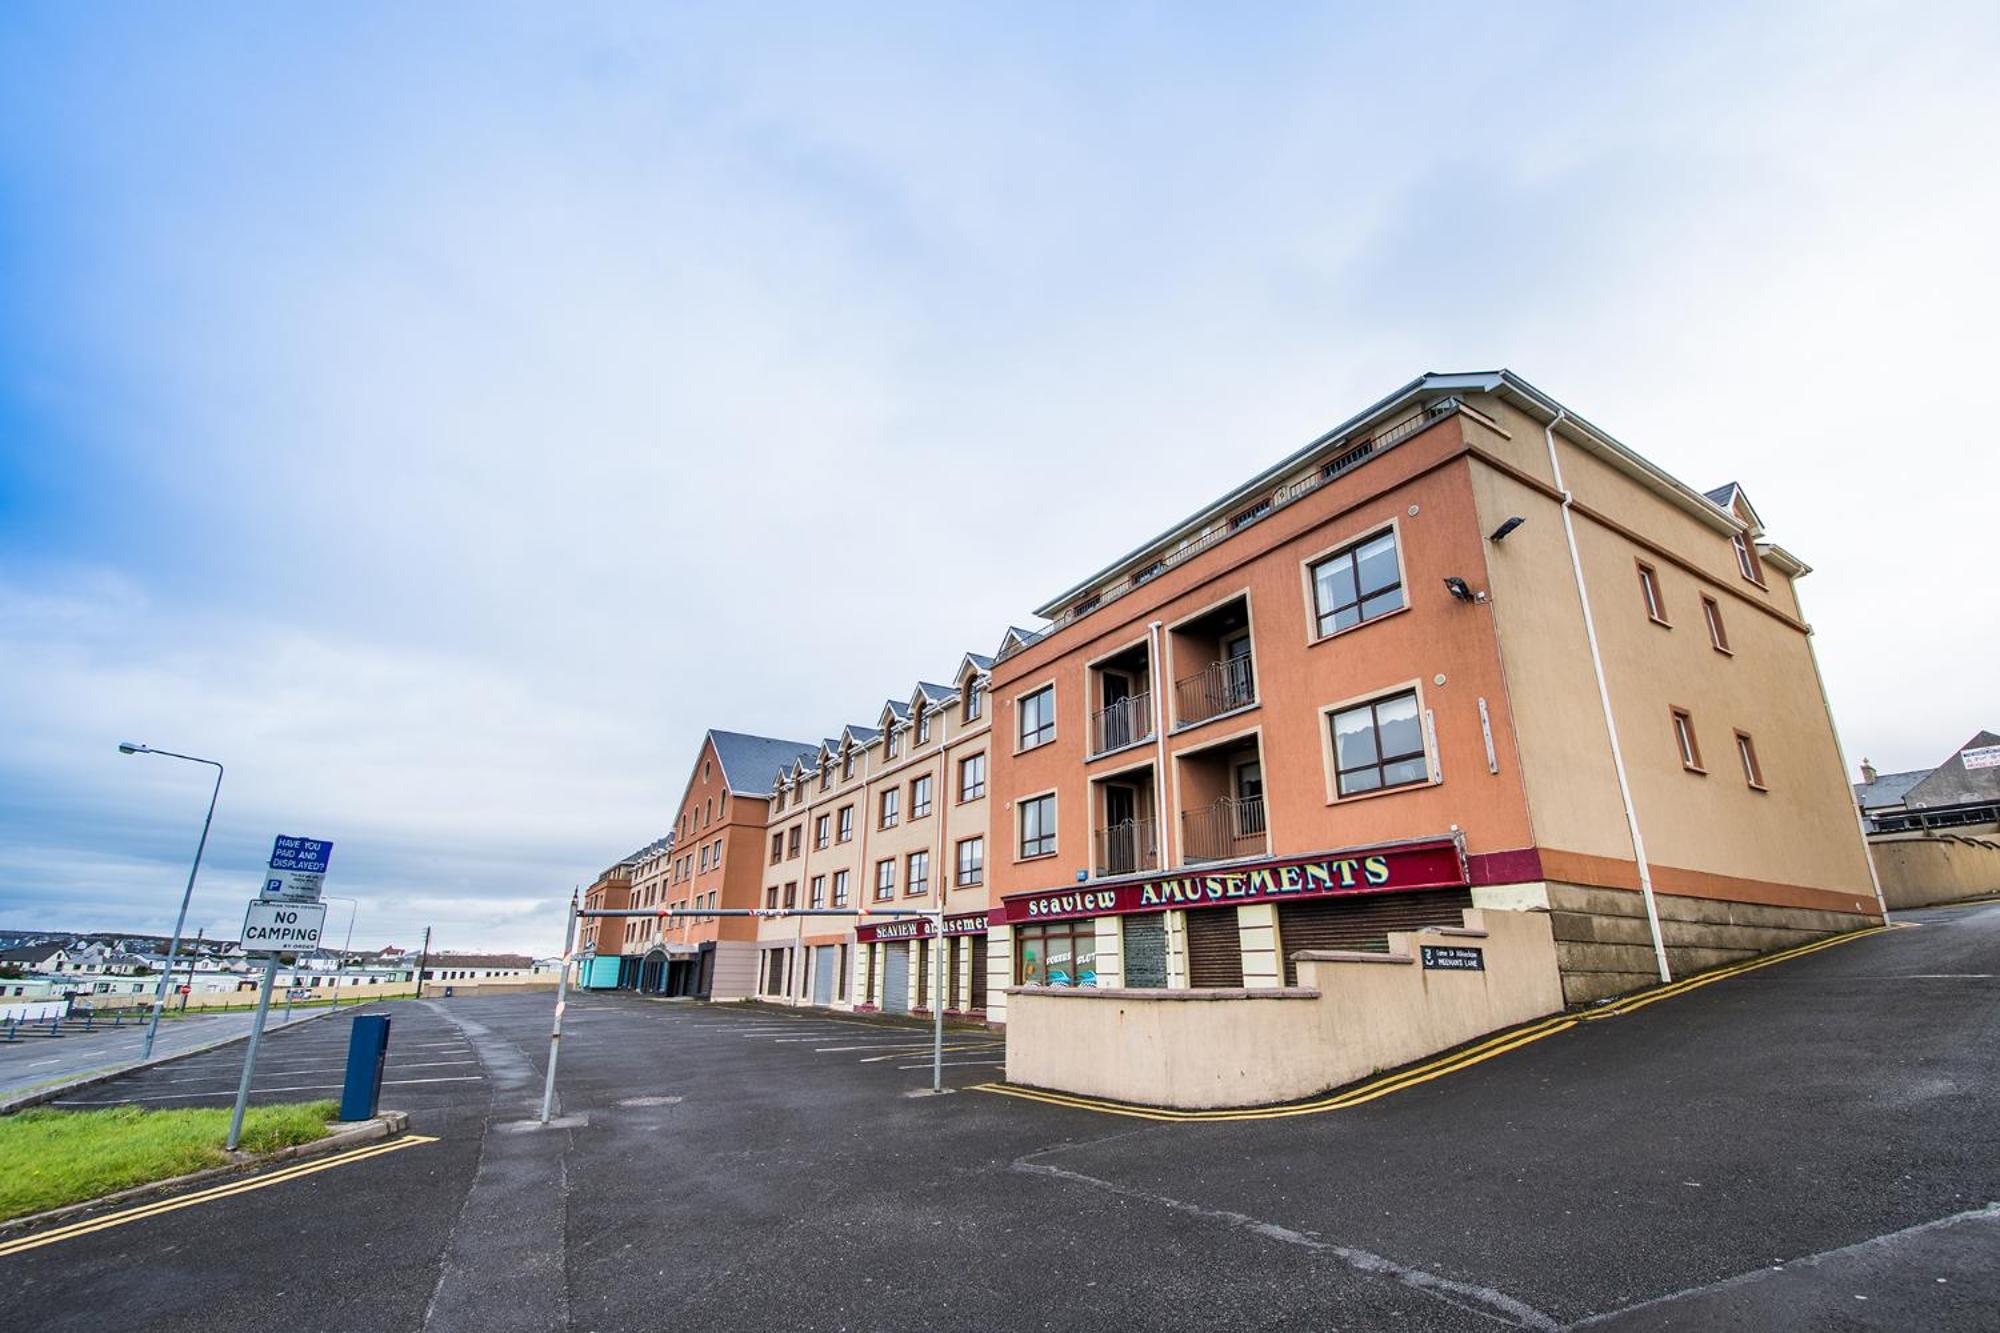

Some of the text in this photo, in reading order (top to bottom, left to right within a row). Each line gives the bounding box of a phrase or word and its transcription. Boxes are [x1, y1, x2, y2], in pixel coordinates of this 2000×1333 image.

[278, 838, 321, 851] HAVE YOU
[275, 848, 317, 860] PAID AND
[272, 859, 325, 871] DISPLAYED?
[270, 881, 279, 890] P
[1140, 855, 1390, 905] AMUSEMENTS
[274, 911, 298, 924] NO
[246, 926, 318, 941] CAMPING
[875, 922, 917, 938] SEAVIEW
